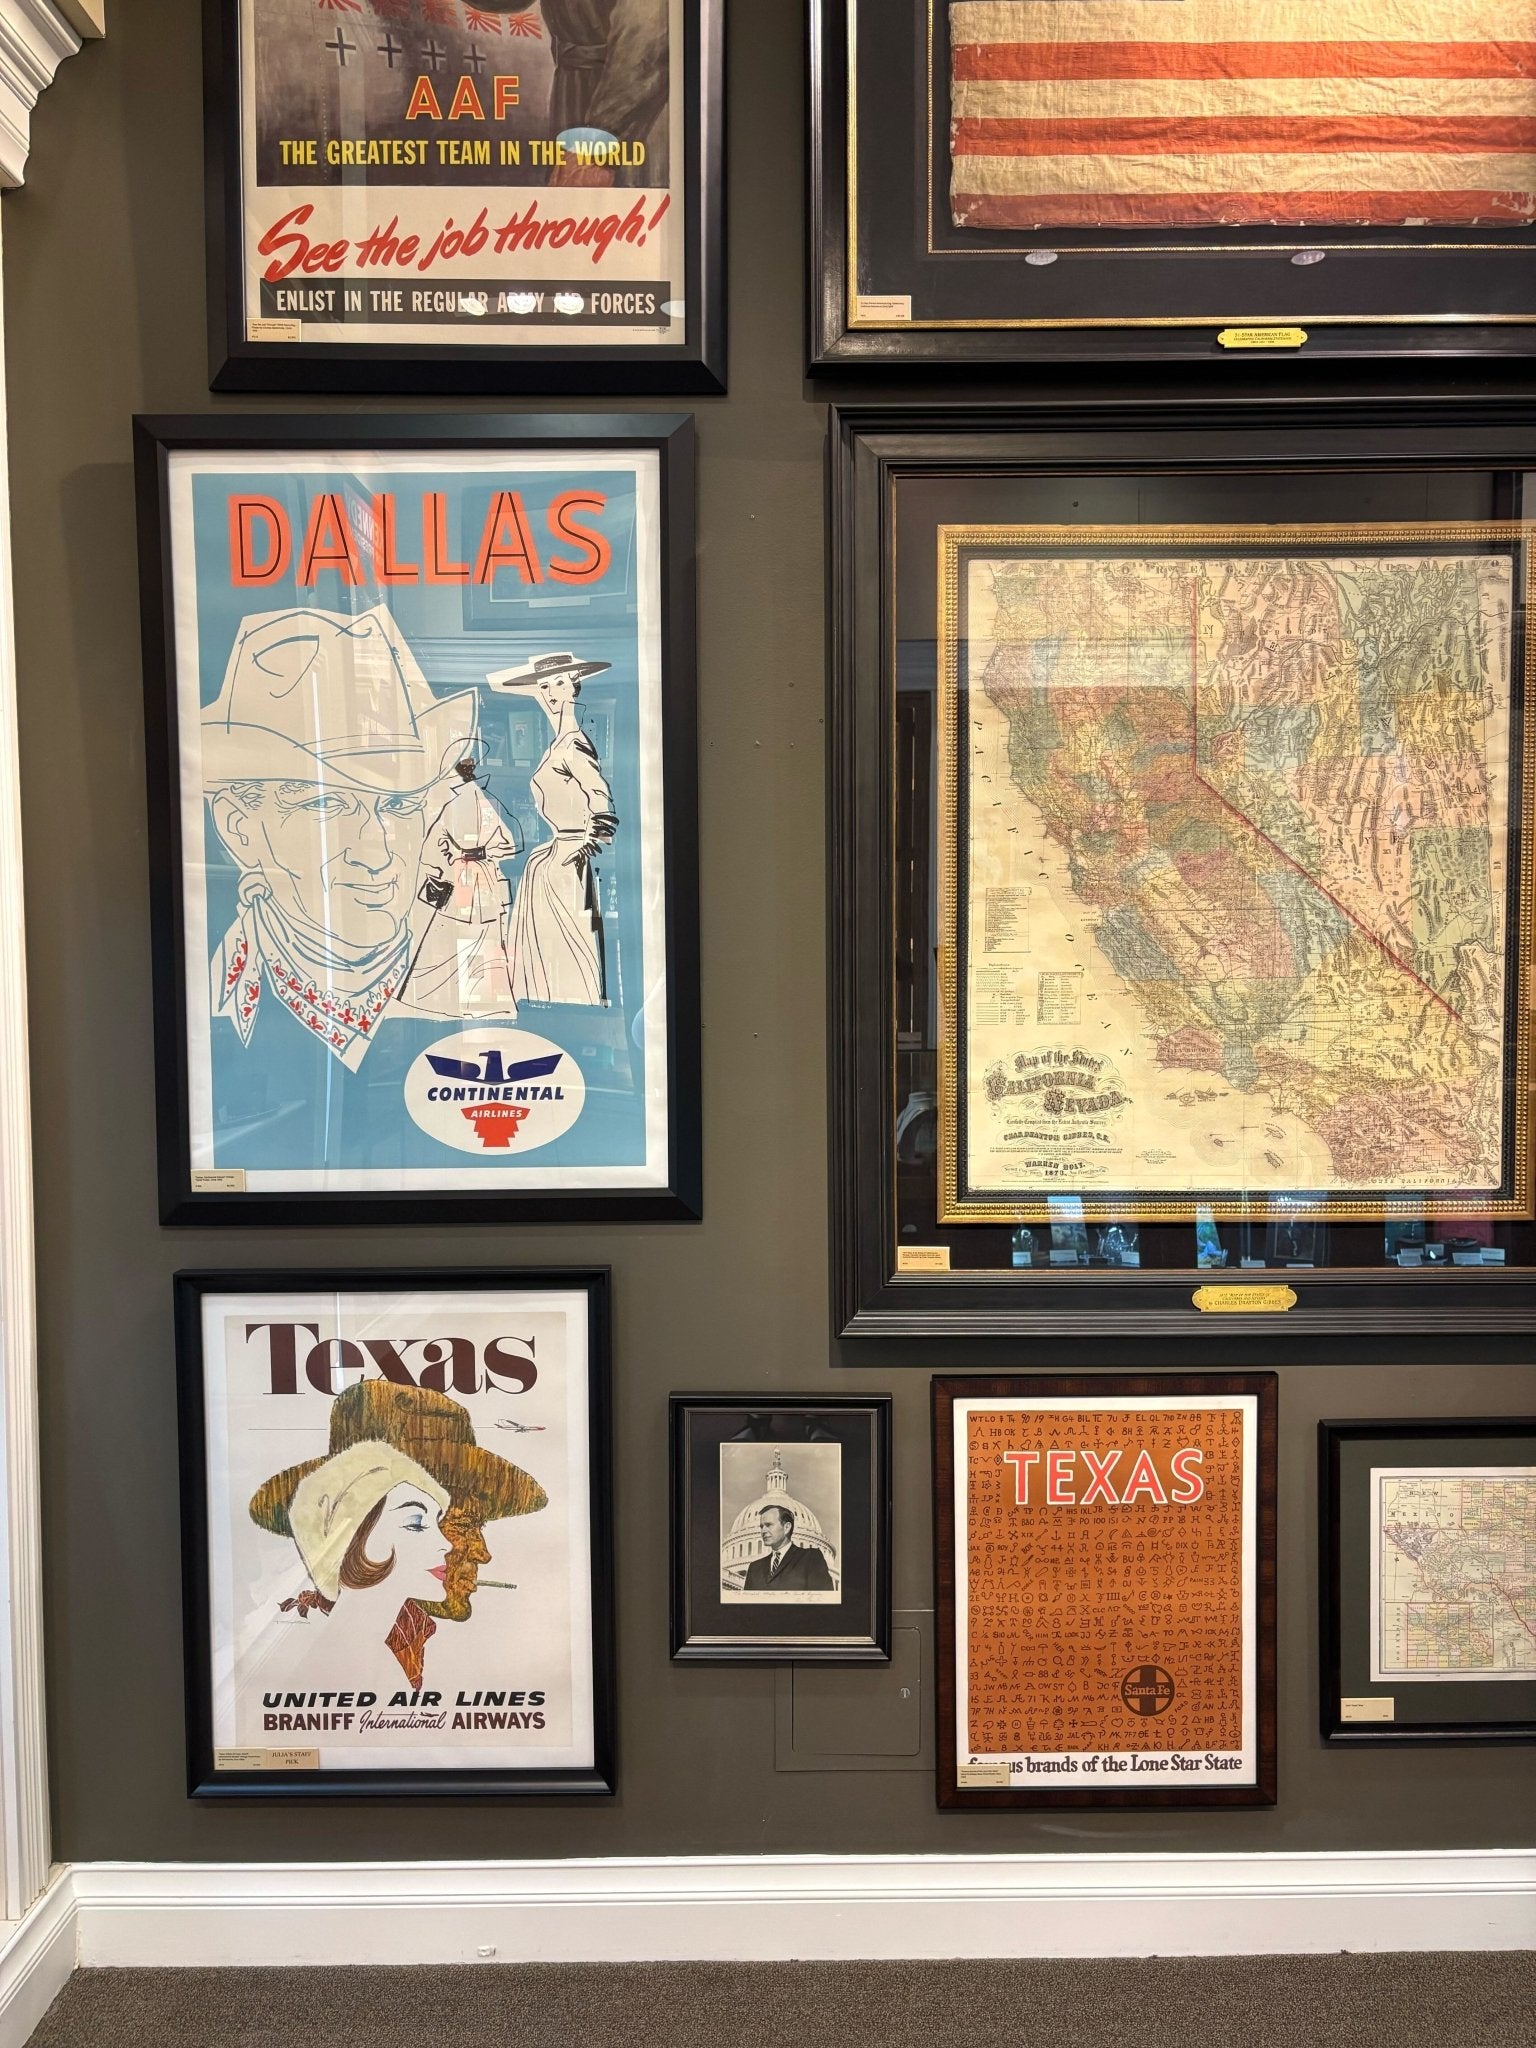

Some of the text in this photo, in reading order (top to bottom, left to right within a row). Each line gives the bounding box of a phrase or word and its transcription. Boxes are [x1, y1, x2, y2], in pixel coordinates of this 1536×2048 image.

[405, 75, 520, 120] AAF
[279, 140, 646, 167] THE GREATEST TEAM IN THE WORLD
[257, 193, 671, 283] See the job through!
[277, 290, 335, 312] ENLIST
[345, 290, 362, 312] IN
[370, 290, 404, 313] THE
[591, 292, 655, 315] FORCES
[228, 491, 612, 588] DALLAS
[427, 1086, 565, 1102] CONTINENTAL
[471, 1109, 523, 1118] AIRLINES
[245, 1323, 538, 1397] Texas
[1003, 1448, 1205, 1505] TEXAS
[262, 1691, 546, 1708] UNITED AIR LINES
[1124, 1684, 1171, 1696] Santa Fe
[263, 1709, 546, 1734] BRANIFF International AIRWAYS
[1024, 1755, 1078, 1774] brands
[1081, 1755, 1100, 1773] of
[1102, 1755, 1128, 1773] the
[1130, 1754, 1169, 1772] Lone
[1170, 1753, 1202, 1771] Star
[1204, 1753, 1243, 1771] State
